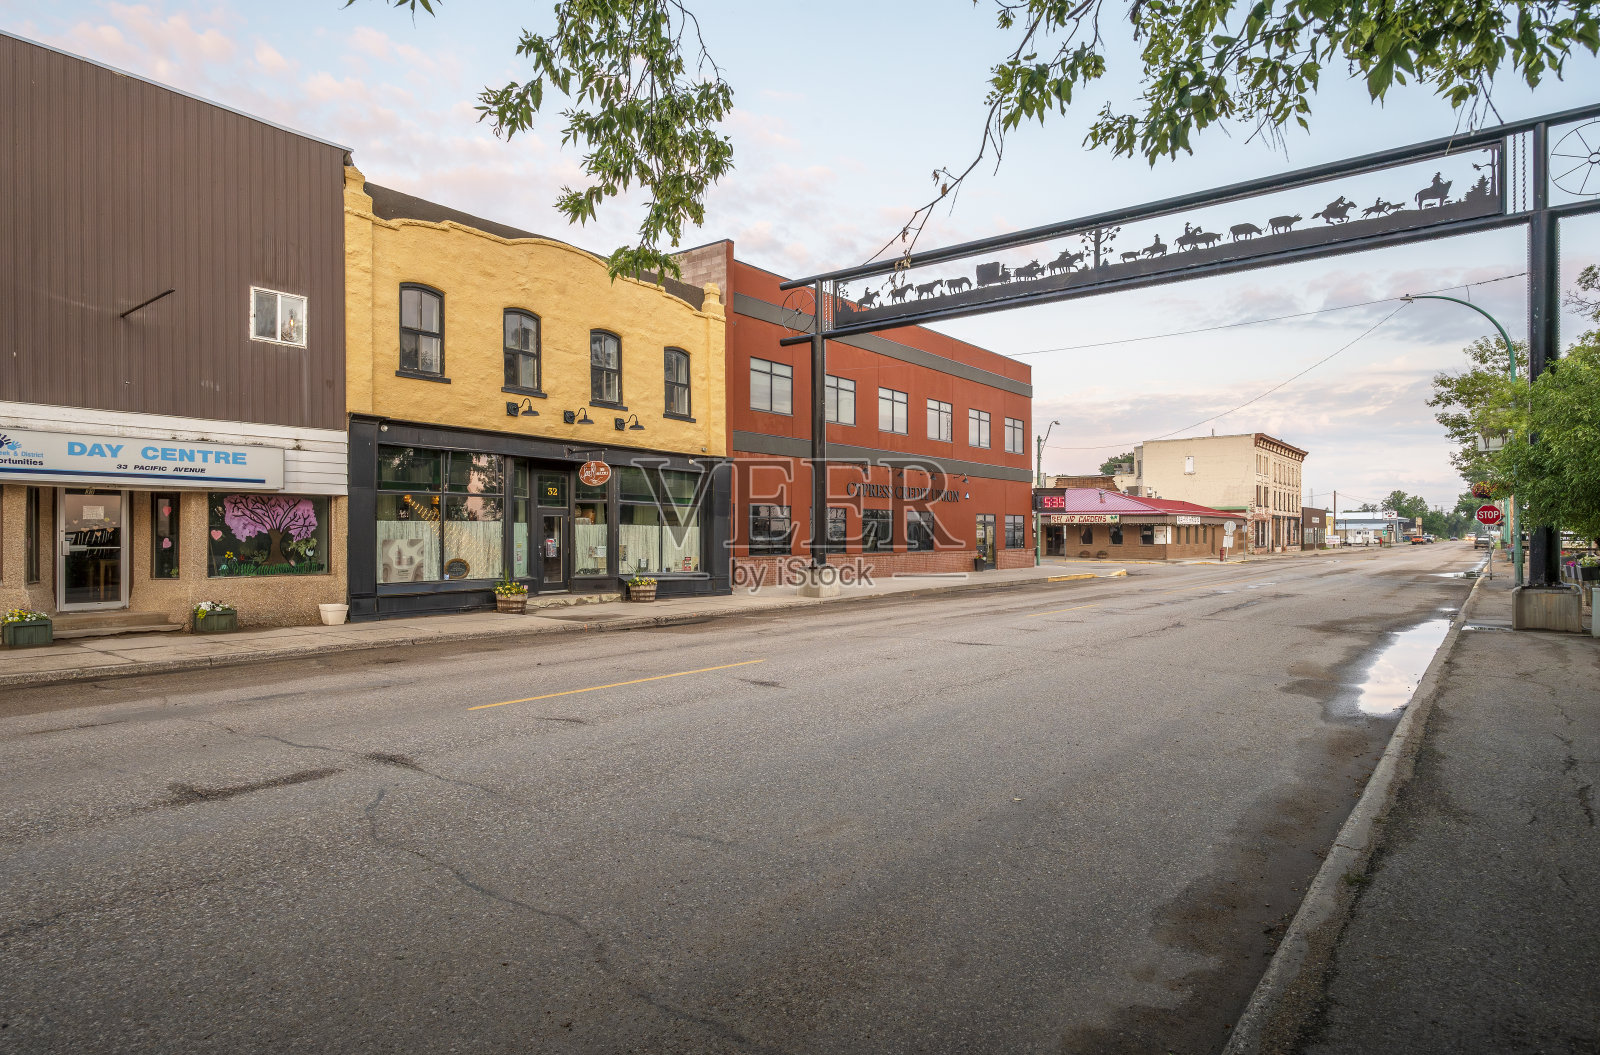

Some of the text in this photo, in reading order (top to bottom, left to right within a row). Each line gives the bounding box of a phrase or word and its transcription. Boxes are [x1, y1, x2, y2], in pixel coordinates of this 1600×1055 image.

[67, 441, 247, 465] DAY CENTRE
[133, 464, 168, 472] PACIFIC
[547, 487, 558, 496] 32
[846, 481, 960, 503] CYPRESS CREDIT UNION
[1478, 510, 1500, 519] STOP
